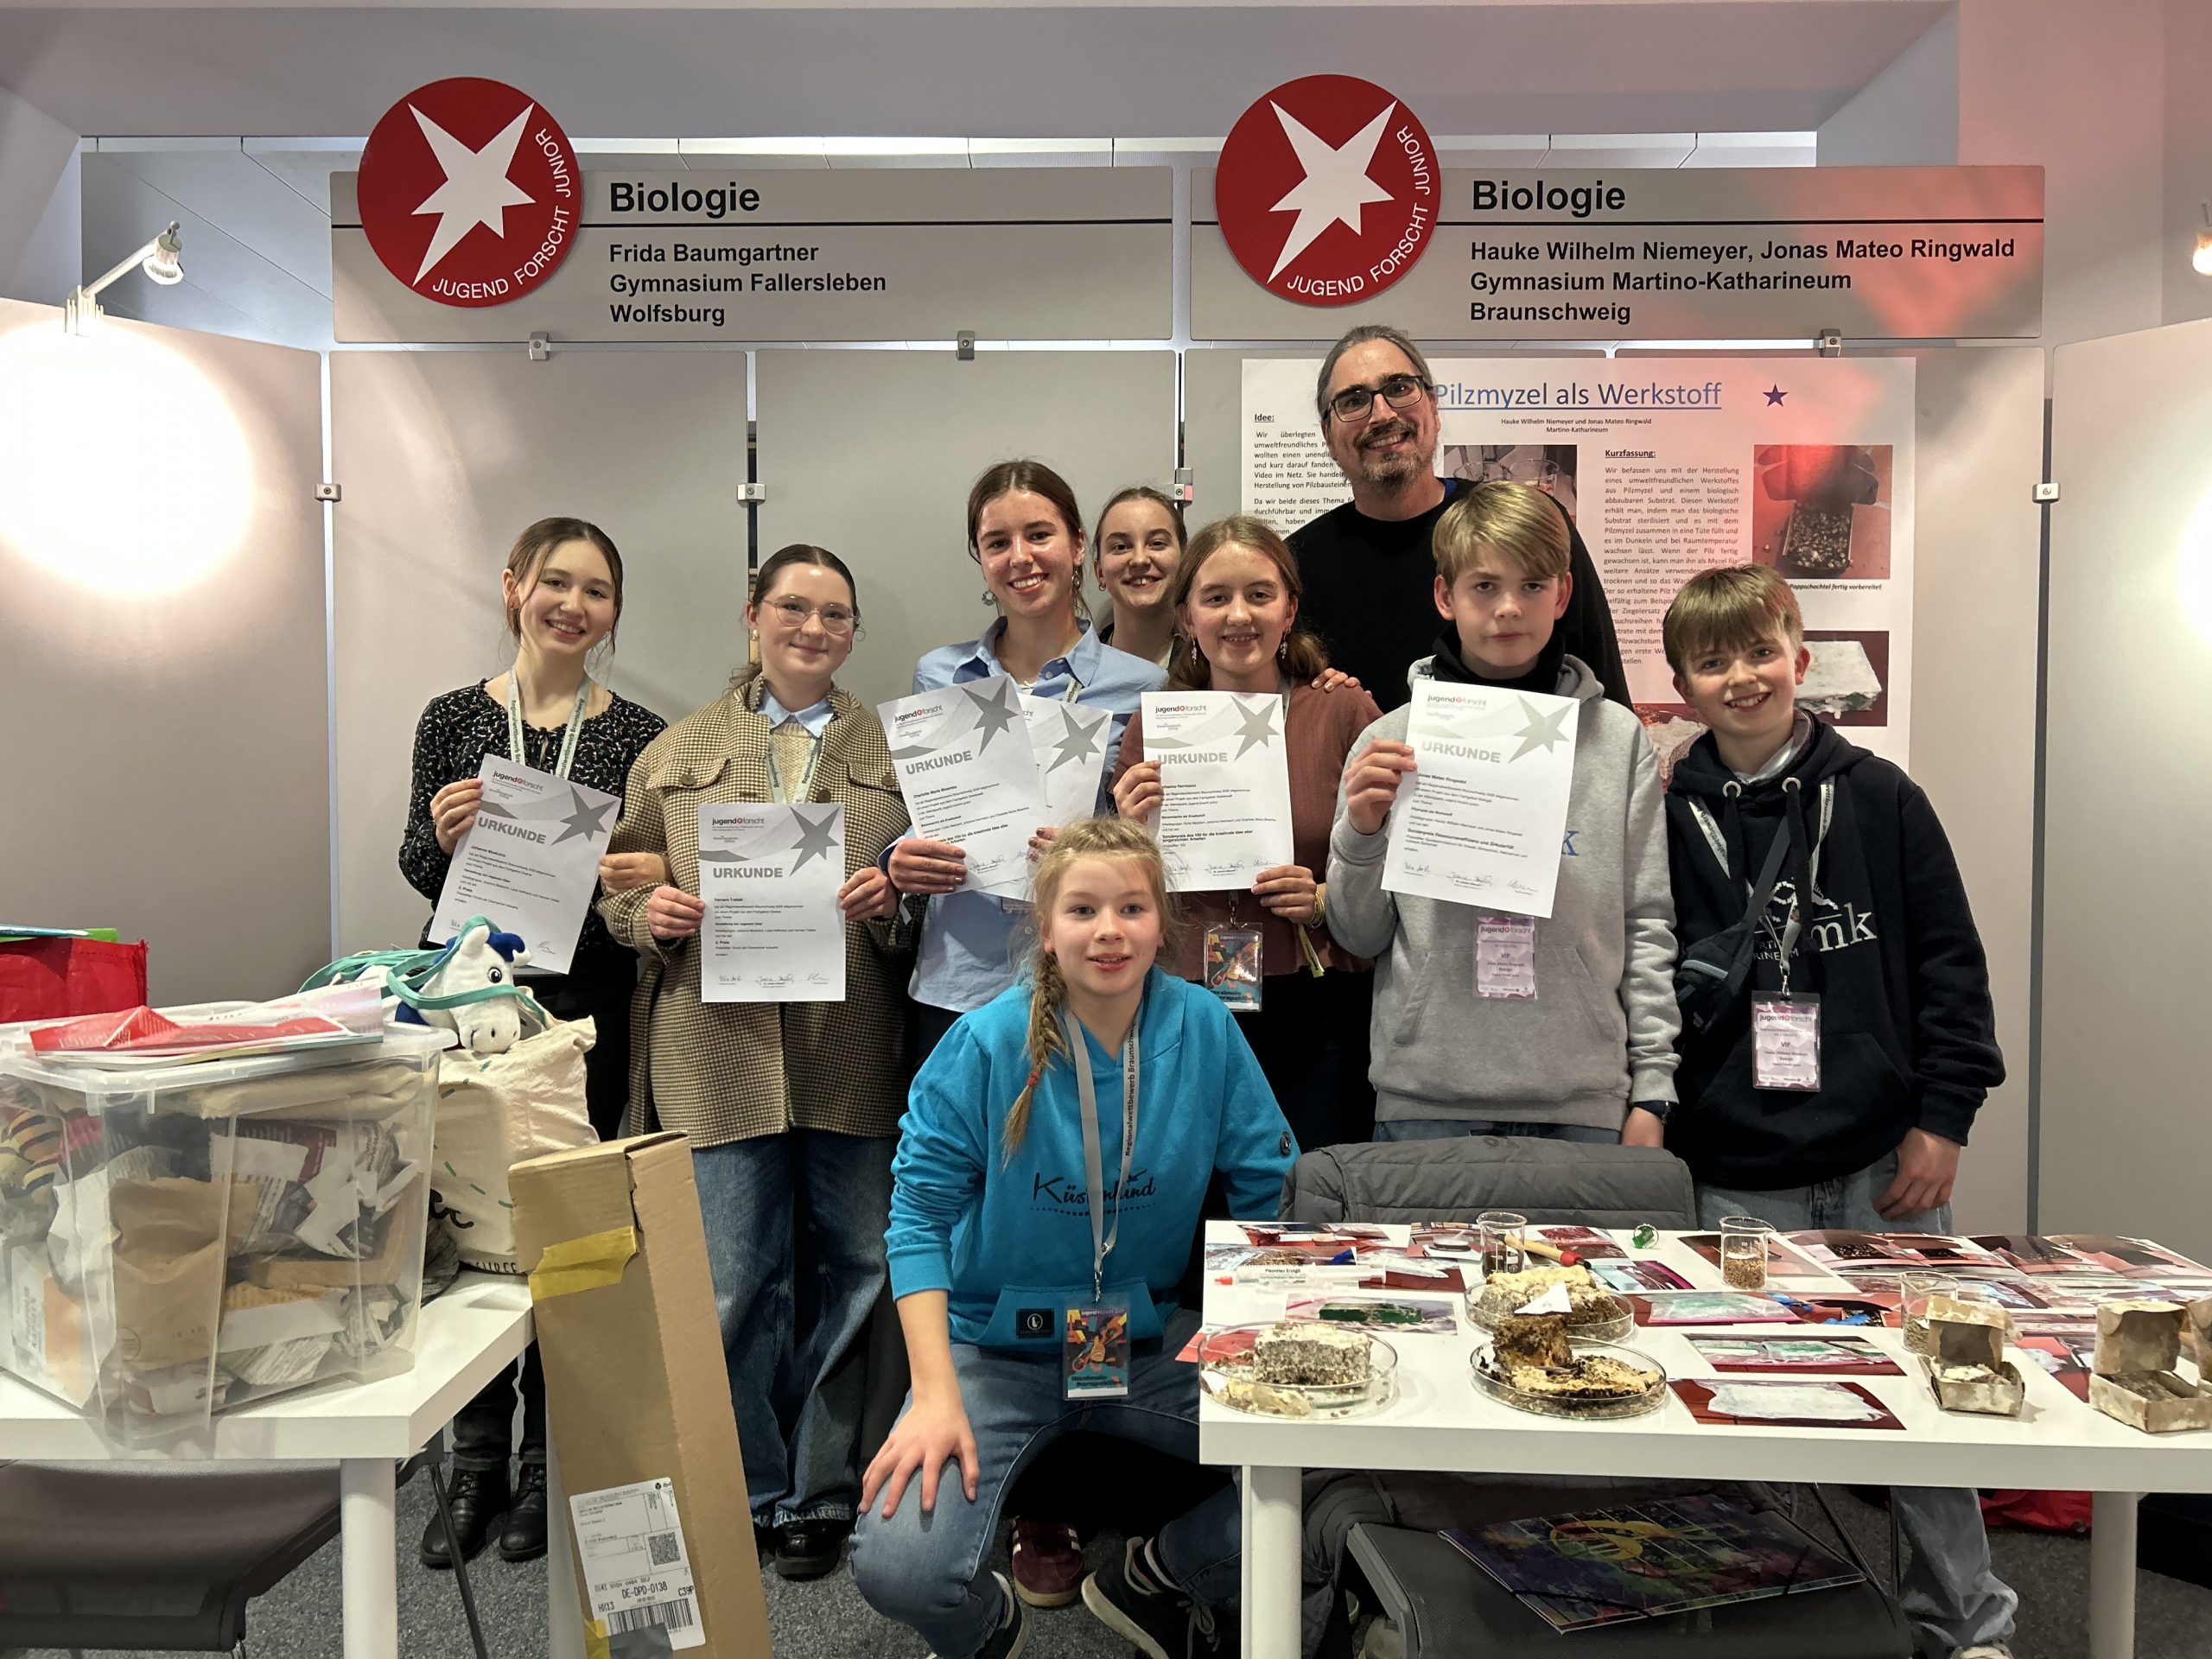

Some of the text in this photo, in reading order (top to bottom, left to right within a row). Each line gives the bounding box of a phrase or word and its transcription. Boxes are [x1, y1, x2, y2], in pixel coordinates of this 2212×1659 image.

[610, 182, 760, 219] Biologie
[1287, 125, 1430, 296] JUGEND FORSCHT JUNIOR
[1473, 181, 1626, 218] Biologie
[433, 128, 570, 298] JUGEND FORSCHT JUNIOR
[610, 245, 819, 266] Frida Baumgartner
[1471, 239, 2014, 264] Hauke Wilhelm Niemeyer, Jonas Mateo Ringwald
[610, 273, 887, 296] Gymnasium Fallersleben
[1471, 271, 1851, 295] Gymnasium Martino-Katharineum
[610, 305, 725, 327] Wolfsburg
[1471, 302, 1630, 325] Braunschweig
[1435, 383, 1722, 408] Pilzmyzel als Werkstoff
[1255, 414, 1274, 423] Idee:
[1605, 449, 1656, 458] Kurzfassung:
[894, 710, 917, 723] jugend
[906, 751, 973, 774] URKUNDE
[1158, 753, 1228, 765] URKUNDE
[1422, 741, 1501, 763] URKUNDE
[493, 771, 518, 782] jugend
[479, 817, 546, 844] URKUNDE
[714, 868, 783, 878] URKUNDE
[1811, 902, 1877, 951] mk
[1126, 1075, 1135, 1156] Regionalwettbewerb
